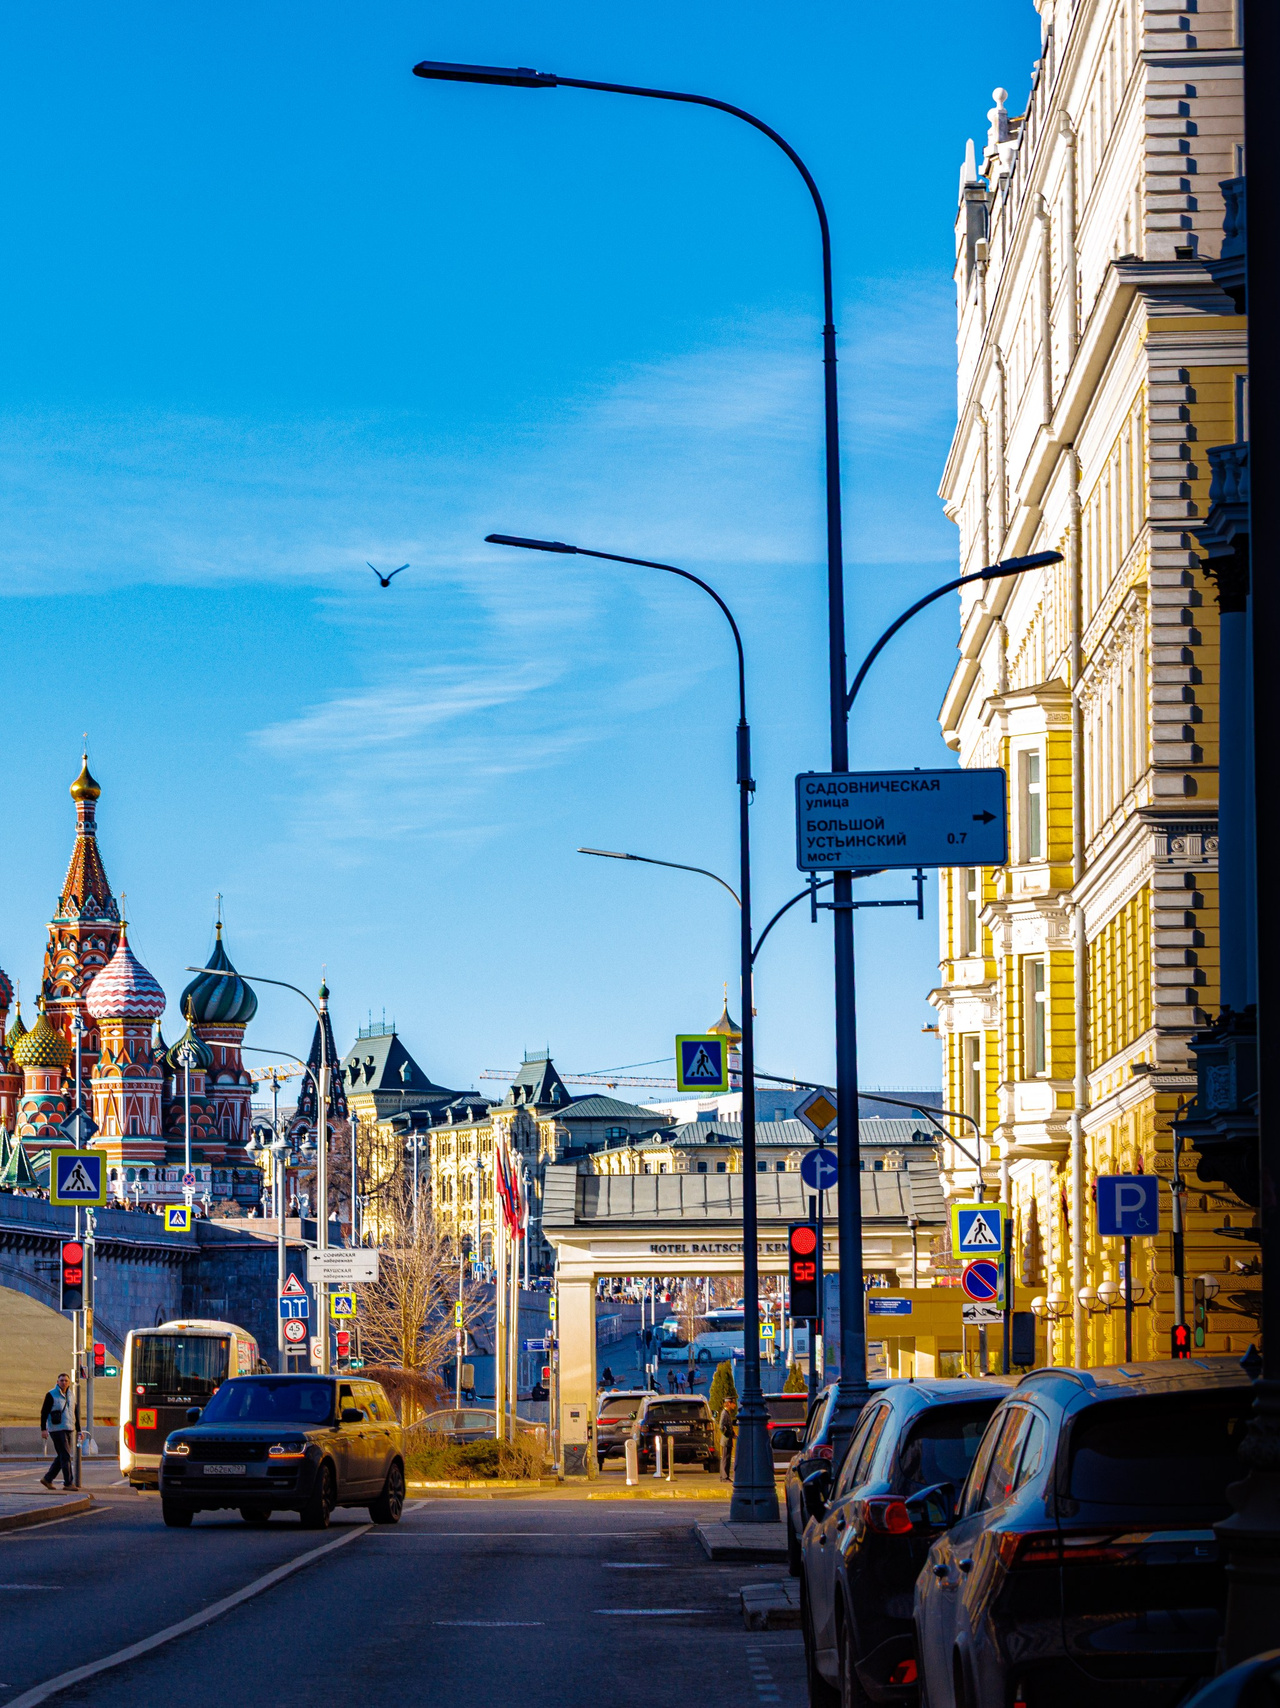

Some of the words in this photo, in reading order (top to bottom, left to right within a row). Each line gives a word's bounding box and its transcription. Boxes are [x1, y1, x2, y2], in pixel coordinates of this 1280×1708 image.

[806, 779, 940, 796] САДОВНИЧЕСКАЯ
[806, 797, 849, 811] улица
[807, 816, 885, 832] БОЛЬШОЙ
[807, 832, 906, 849] УСТЬИНСКИЙ
[947, 833, 967, 845] 0.7
[807, 851, 842, 863] мост
[1115, 1183, 1146, 1228] P
[650, 1244, 689, 1253] HOTEL
[692, 1243, 762, 1253] BALTSCHG
[64, 1268, 82, 1284] 52
[793, 1262, 816, 1281] 52
